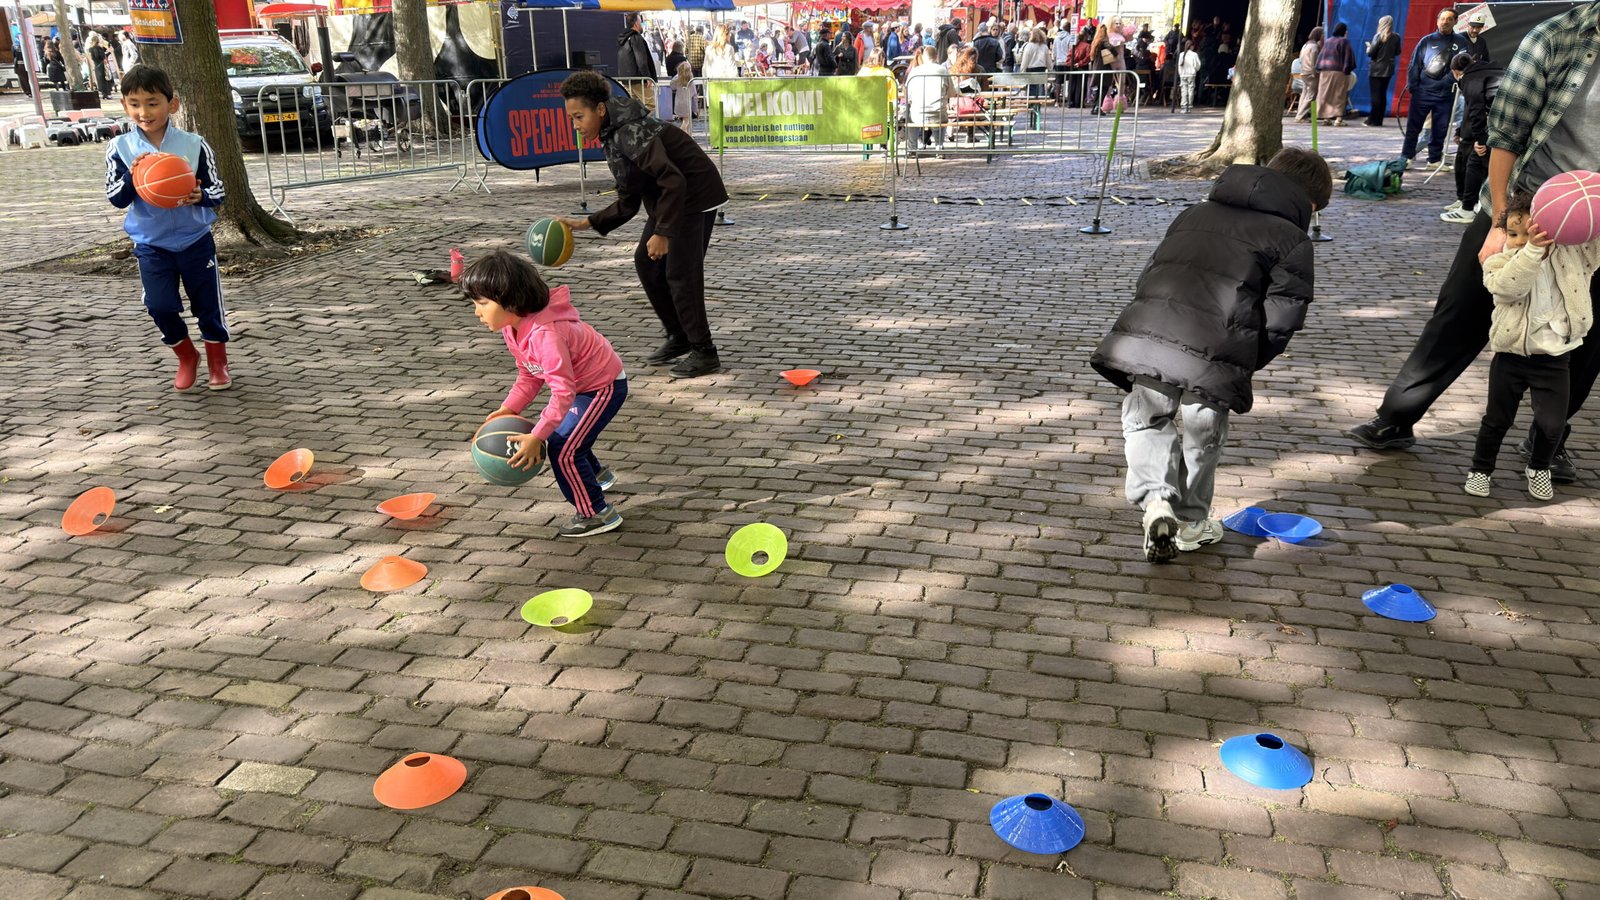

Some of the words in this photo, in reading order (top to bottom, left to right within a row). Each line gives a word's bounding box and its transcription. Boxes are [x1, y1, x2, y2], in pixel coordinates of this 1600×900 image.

[720, 90, 823, 117] WELKOM!
[725, 124, 745, 133] Vanaf
[746, 124, 761, 132] hier
[762, 123, 770, 132] is
[770, 123, 782, 132] het
[783, 123, 815, 132] nuttigen
[739, 135, 767, 143] alcohol
[767, 134, 808, 143] toegestaan
